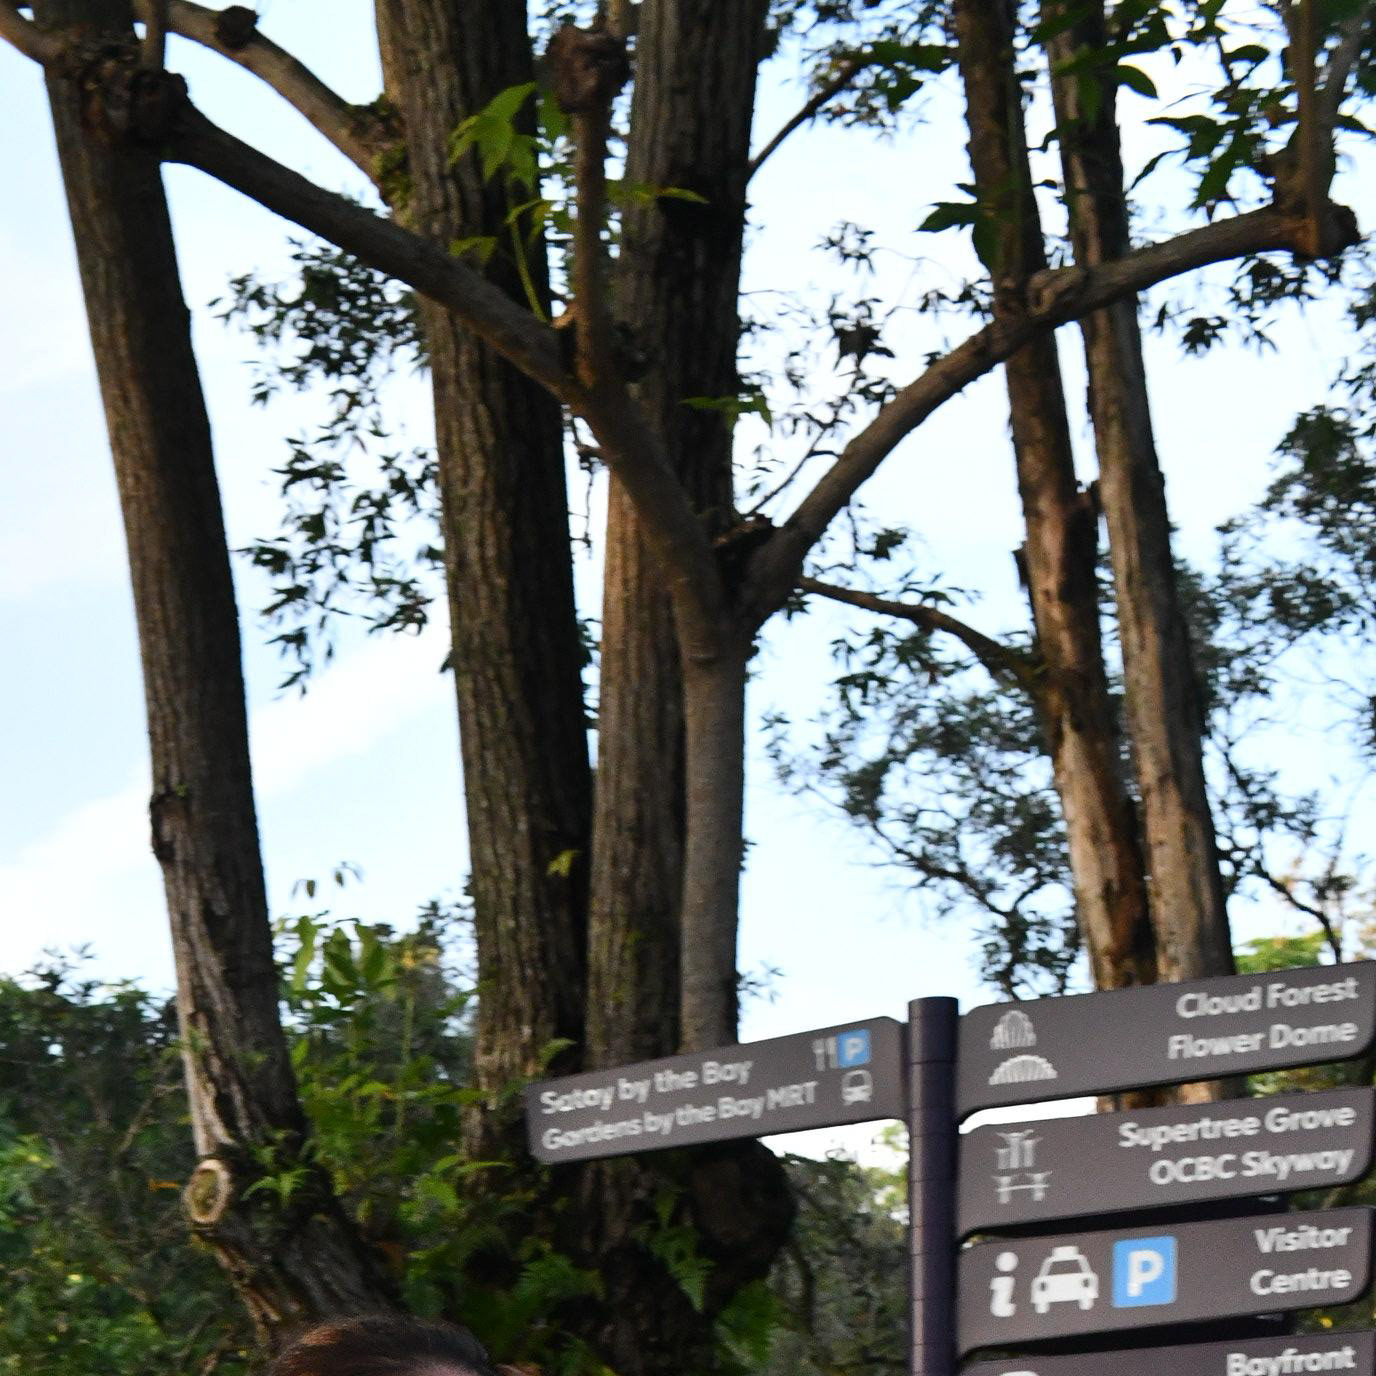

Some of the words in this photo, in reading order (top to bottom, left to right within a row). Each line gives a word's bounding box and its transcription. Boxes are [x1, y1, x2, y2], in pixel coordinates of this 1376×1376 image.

[1176, 984, 1262, 1019] Cloud
[1266, 976, 1360, 1010] Forest
[1167, 1030, 1266, 1061] Flower
[1268, 1019, 1359, 1051] Dome
[540, 1083, 613, 1115] Satay
[617, 1076, 650, 1103] by
[654, 1069, 699, 1094] the
[701, 1059, 753, 1087] Bay
[540, 1117, 643, 1151] Gardens
[642, 1109, 674, 1136] by
[675, 1102, 717, 1127] the
[717, 1094, 767, 1120] Bay
[766, 1080, 819, 1110] MRT
[1119, 1113, 1261, 1152] Supertree
[1264, 1105, 1357, 1134] Grove
[1148, 1153, 1238, 1186] OCBC
[1241, 1147, 1356, 1182] Skyway
[1253, 1224, 1354, 1255] Visitor
[1249, 1265, 1354, 1297] Centre
